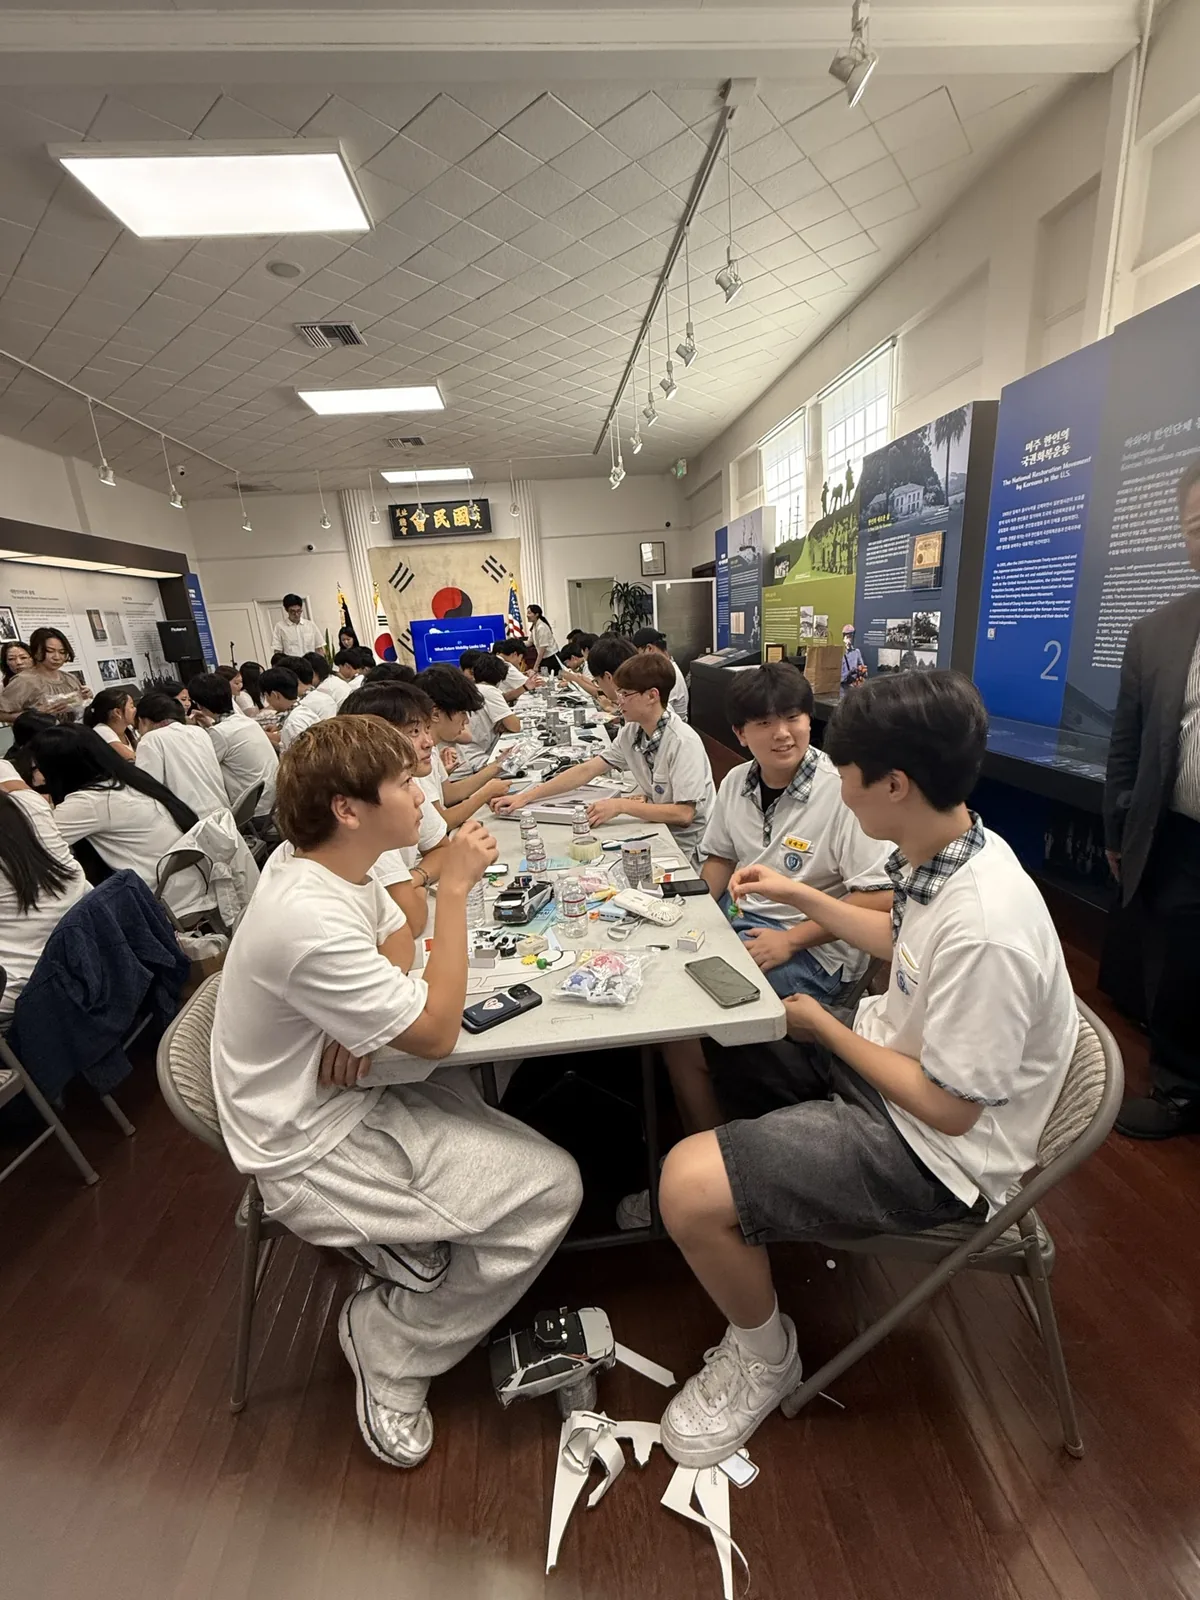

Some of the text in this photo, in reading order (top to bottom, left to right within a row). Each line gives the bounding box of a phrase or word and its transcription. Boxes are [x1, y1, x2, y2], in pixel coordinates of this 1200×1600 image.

[1012, 472, 1031, 484] National
[1032, 465, 1062, 478] Restoration
[1063, 456, 1092, 470] Movement
[1023, 478, 1043, 488] Koreans
[1060, 469, 1071, 478] U.S.
[1040, 640, 1062, 680] 2
